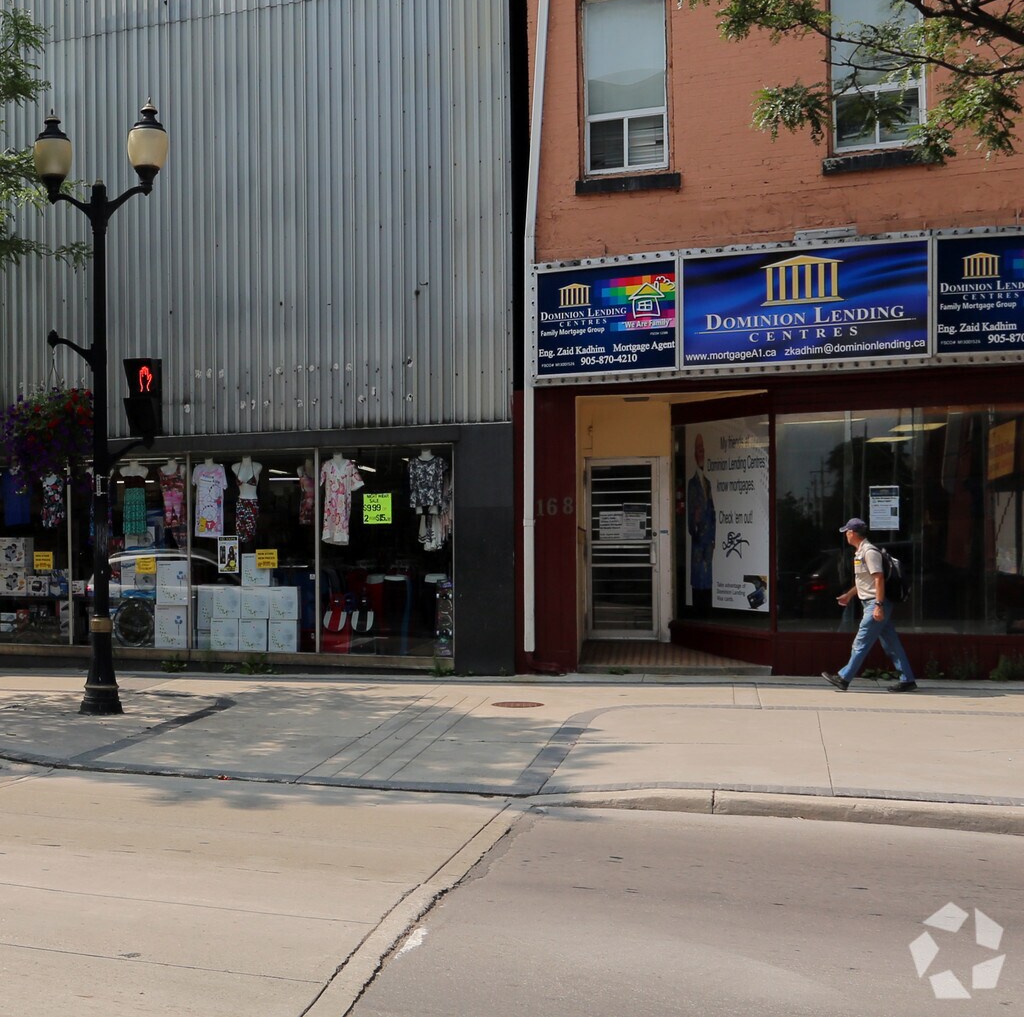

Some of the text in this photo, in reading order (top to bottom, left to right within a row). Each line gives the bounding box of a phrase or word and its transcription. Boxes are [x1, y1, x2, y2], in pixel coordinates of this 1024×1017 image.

[939, 282, 993, 293] DOMINION
[962, 292, 1020, 301] CENTRES
[939, 301, 1017, 311] Family Mortgage Group
[540, 307, 627, 321] DOMINION LENDING
[705, 305, 905, 331] DOMINION LENDING
[559, 319, 607, 328] CENTRES
[635, 320, 648, 328] Are
[937, 321, 1017, 335] Eng. Zaid Kadhim
[540, 326, 605, 337] Family Mortgage Group
[748, 325, 858, 343] CENTRES
[538, 340, 676, 358] Eng. Zaid Kadhim Mortgage Agent
[685, 339, 926, 363] www.mortgageA1.ca zkadhim@dominionlending.ca
[580, 353, 638, 366] 905-870-4210
[707, 455, 765, 473] Dominion Lending Centres
[717, 480, 728, 492] know
[536, 496, 574, 516] 168
[364, 514, 369, 522] 2
[719, 511, 733, 525] Check
